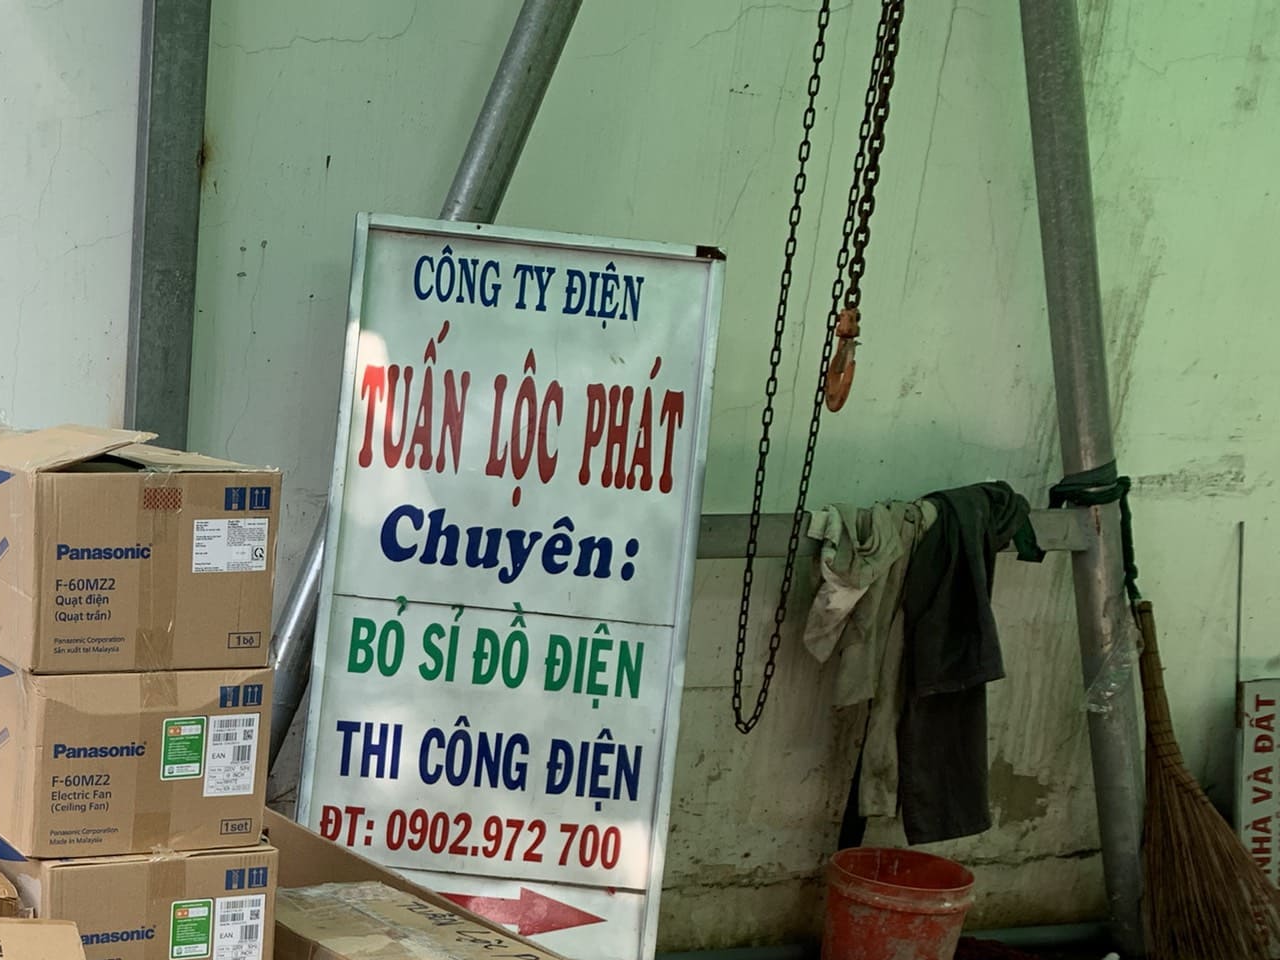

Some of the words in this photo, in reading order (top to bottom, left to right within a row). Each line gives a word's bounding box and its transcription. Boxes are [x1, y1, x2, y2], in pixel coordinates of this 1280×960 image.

[414, 244, 502, 307] CÔNG
[513, 265, 556, 311] TY
[563, 261, 644, 329] ĐIỆN
[358, 320, 471, 474] TUẤN
[485, 348, 564, 507] LỘC
[578, 356, 684, 494] PHÁT
[56, 543, 153, 561] Panasonic
[380, 504, 639, 584] Chuyên:
[55, 577, 117, 592] F-60MZ2
[55, 595, 82, 608] Quạt
[85, 594, 110, 608] điện
[54, 611, 83, 624] (Quạt
[54, 637, 85, 646] Panasonic
[87, 636, 126, 645] Corporation
[92, 645, 120, 655] Malaysia
[347, 596, 408, 677] BỎ
[419, 604, 465, 682] SỈ
[472, 602, 529, 688] ĐỒ
[544, 623, 644, 709] ĐIỆN
[1244, 693, 1277, 754] ĐẤT
[53, 741, 147, 760] Panasonic
[211, 752, 227, 761] EAN
[336, 720, 403, 780] THI
[420, 715, 530, 791] CÔNG
[546, 728, 642, 811] ĐIỆN
[51, 774, 111, 788] F-60MZ2
[1246, 765, 1274, 805] VÀ
[51, 790, 90, 801] Electric
[92, 789, 112, 800] Fan
[50, 803, 87, 814] (Ceiling
[89, 801, 110, 812] Fan)
[49, 828, 80, 837] Panasonic
[81, 827, 119, 836] Corporation
[321, 805, 374, 847] ĐT:
[386, 809, 547, 862] 0902.972
[558, 824, 621, 870] 700
[49, 838, 67, 846] Made
[76, 837, 103, 845] Malaysia
[81, 925, 157, 946] anasonic
